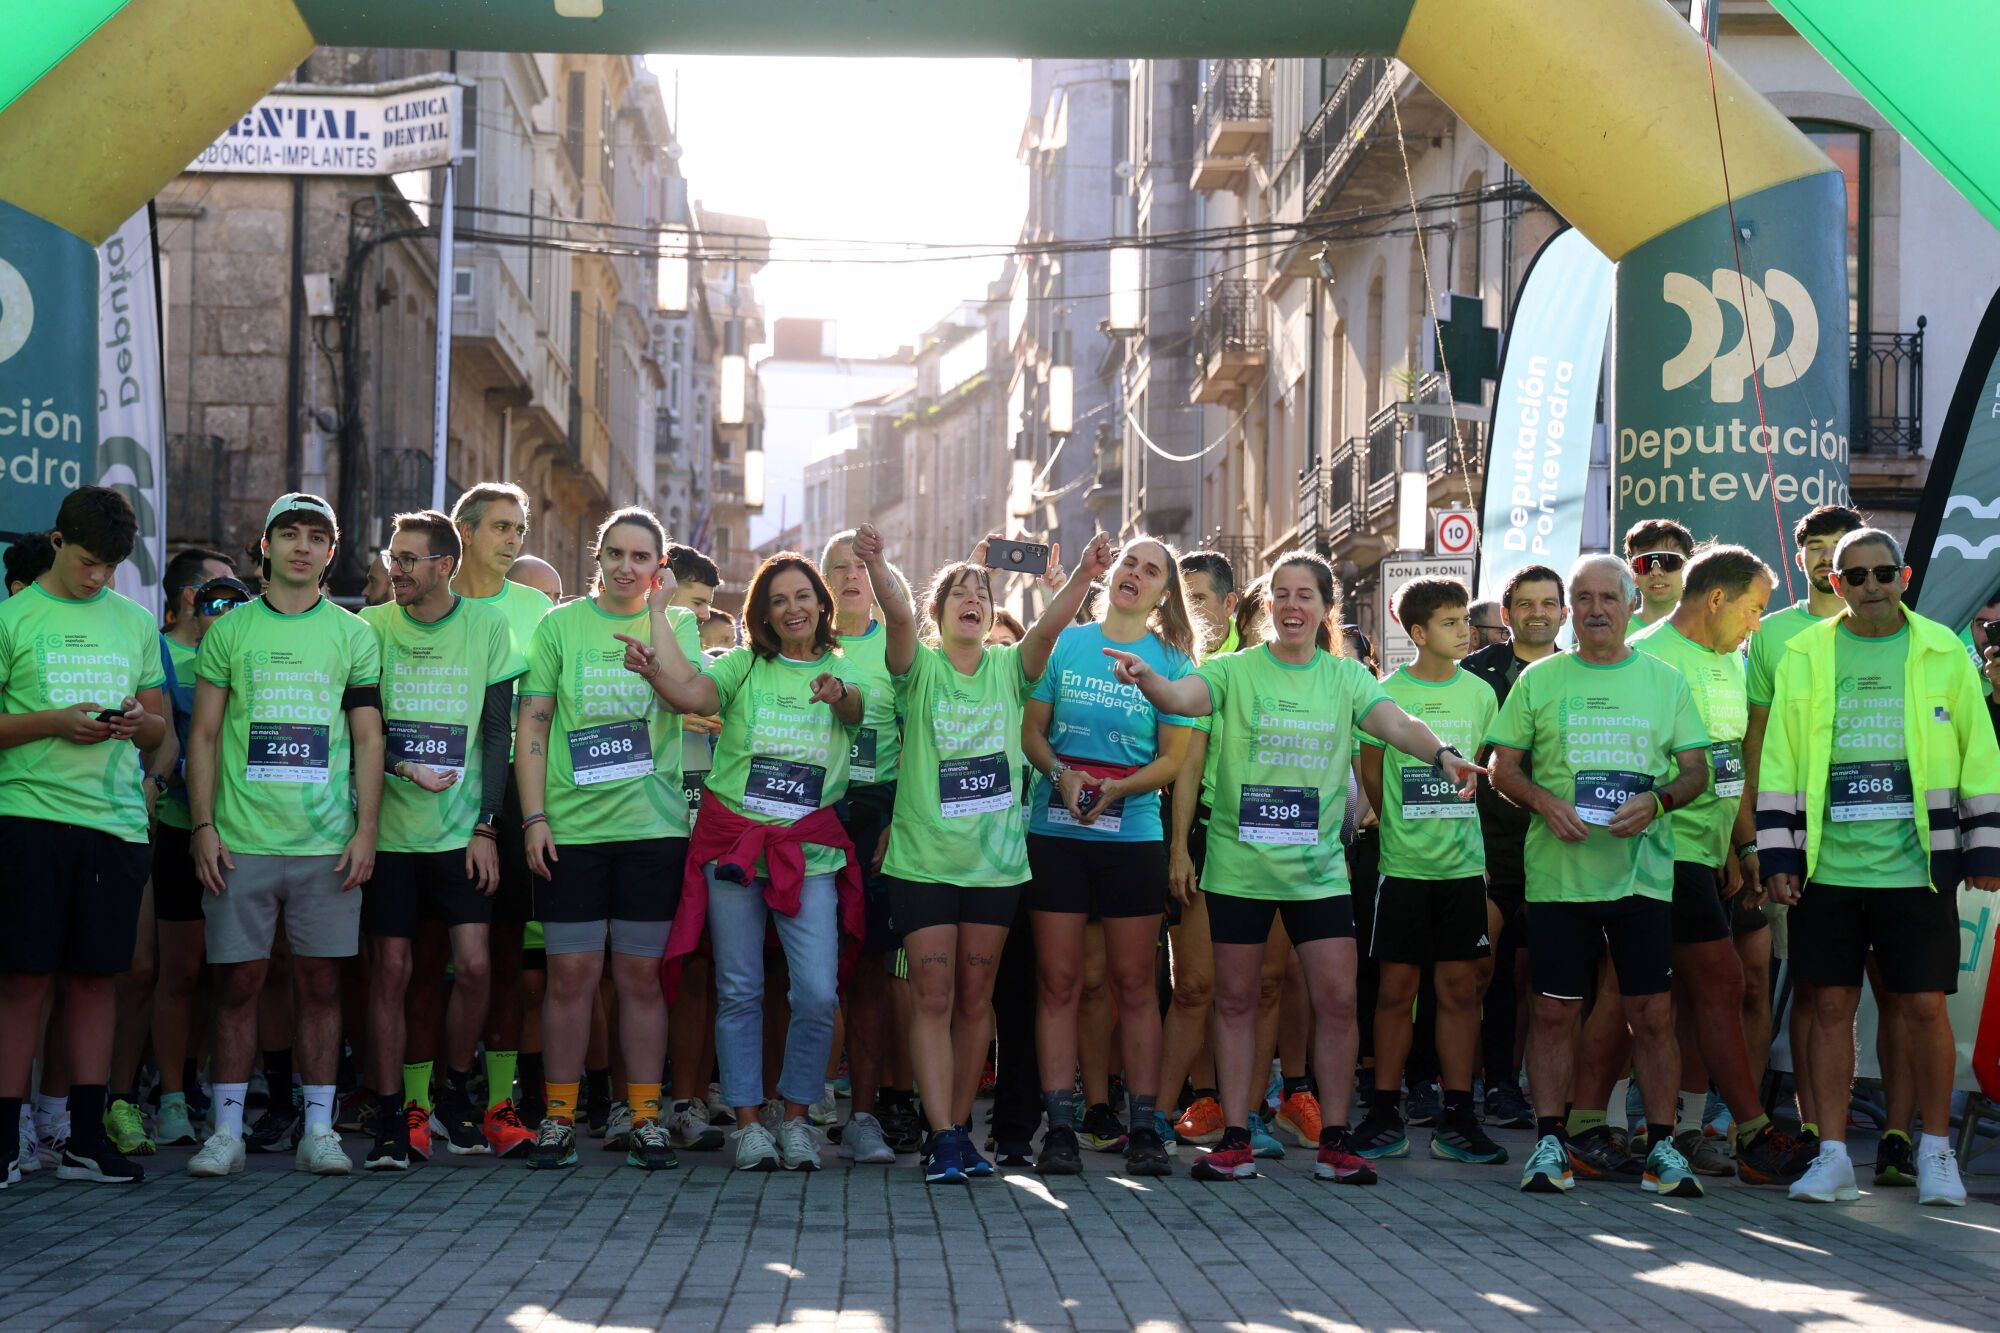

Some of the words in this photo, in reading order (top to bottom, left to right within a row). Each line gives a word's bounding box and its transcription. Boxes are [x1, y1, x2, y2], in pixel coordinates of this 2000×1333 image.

[384, 96, 448, 124] CLINICA
[229, 107, 369, 140] ENTAL
[383, 122, 448, 149] DENTAL
[197, 144, 376, 168] ODONCIA-IMPLANTES
[1620, 418, 1848, 469] Deputación
[1504, 355, 1548, 551] Deputación
[1532, 360, 1573, 556] Pontevedra
[1620, 467, 1849, 510] Pontevedra
[1449, 527, 1463, 539] 10
[1389, 567, 1421, 577] ZONA
[47, 652, 66, 664] En
[71, 653, 129, 668] marcha
[253, 669, 270, 682] En
[275, 670, 329, 683] marcha
[395, 663, 412, 675] En
[417, 665, 468, 676] marcha
[584, 666, 602, 678] En
[47, 669, 113, 684] contra
[116, 674, 128, 687] o
[1062, 670, 1081, 686] En
[254, 685, 312, 701] contra
[319, 690, 330, 702] o
[393, 680, 452, 694] contra
[457, 683, 468, 694] o
[583, 681, 646, 696] contra
[393, 698, 468, 712] cancro
[938, 701, 952, 712] En
[1839, 696, 1858, 709] En
[1864, 697, 1904, 708] marc
[252, 704, 331, 720] cancro
[757, 707, 775, 719] En
[780, 712, 832, 724] marcha
[1837, 712, 1904, 728] contra
[934, 719, 990, 733] contra
[994, 720, 1004, 730] o
[1261, 714, 1279, 727] En
[1283, 719, 1336, 732] marcha
[1568, 714, 1587, 726] En
[1592, 715, 1649, 728] marcha
[753, 724, 814, 742] contra
[819, 732, 830, 743] o
[1567, 730, 1631, 745] contra
[1637, 735, 1648, 748] o
[405, 740, 447, 754] 2488
[589, 738, 632, 757] 0888
[935, 735, 1005, 751] cancro
[1258, 733, 1319, 750] contra
[1324, 740, 1332, 751] o
[267, 743, 310, 758] 2403
[752, 740, 828, 761] cancro
[1568, 749, 1646, 767] cancro
[1258, 750, 1329, 769] cancro
[766, 778, 804, 796] 2274
[960, 773, 995, 790] 1397
[1421, 782, 1457, 796] 1981
[1848, 778, 1893, 794] 2668
[685, 789, 701, 802] 95
[1260, 804, 1300, 820] 1398
